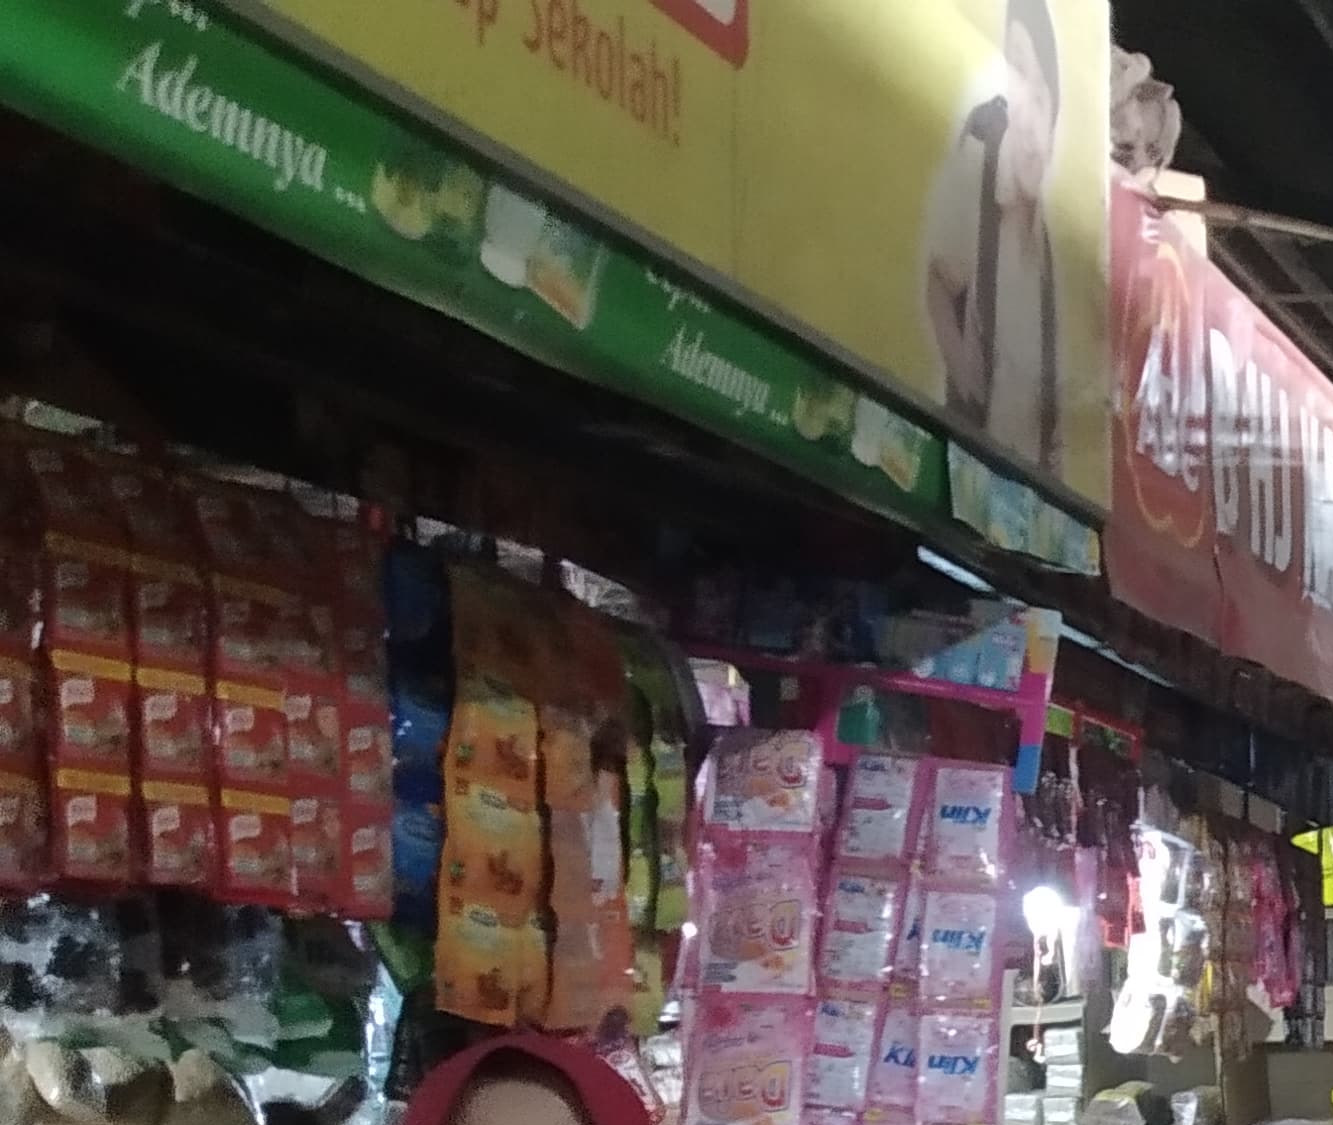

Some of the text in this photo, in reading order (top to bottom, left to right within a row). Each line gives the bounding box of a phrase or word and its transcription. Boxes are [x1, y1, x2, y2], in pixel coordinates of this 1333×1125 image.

[938, 804, 992, 824] Klin
[931, 928, 987, 953] Klin
[927, 1054, 980, 1076] Klin
